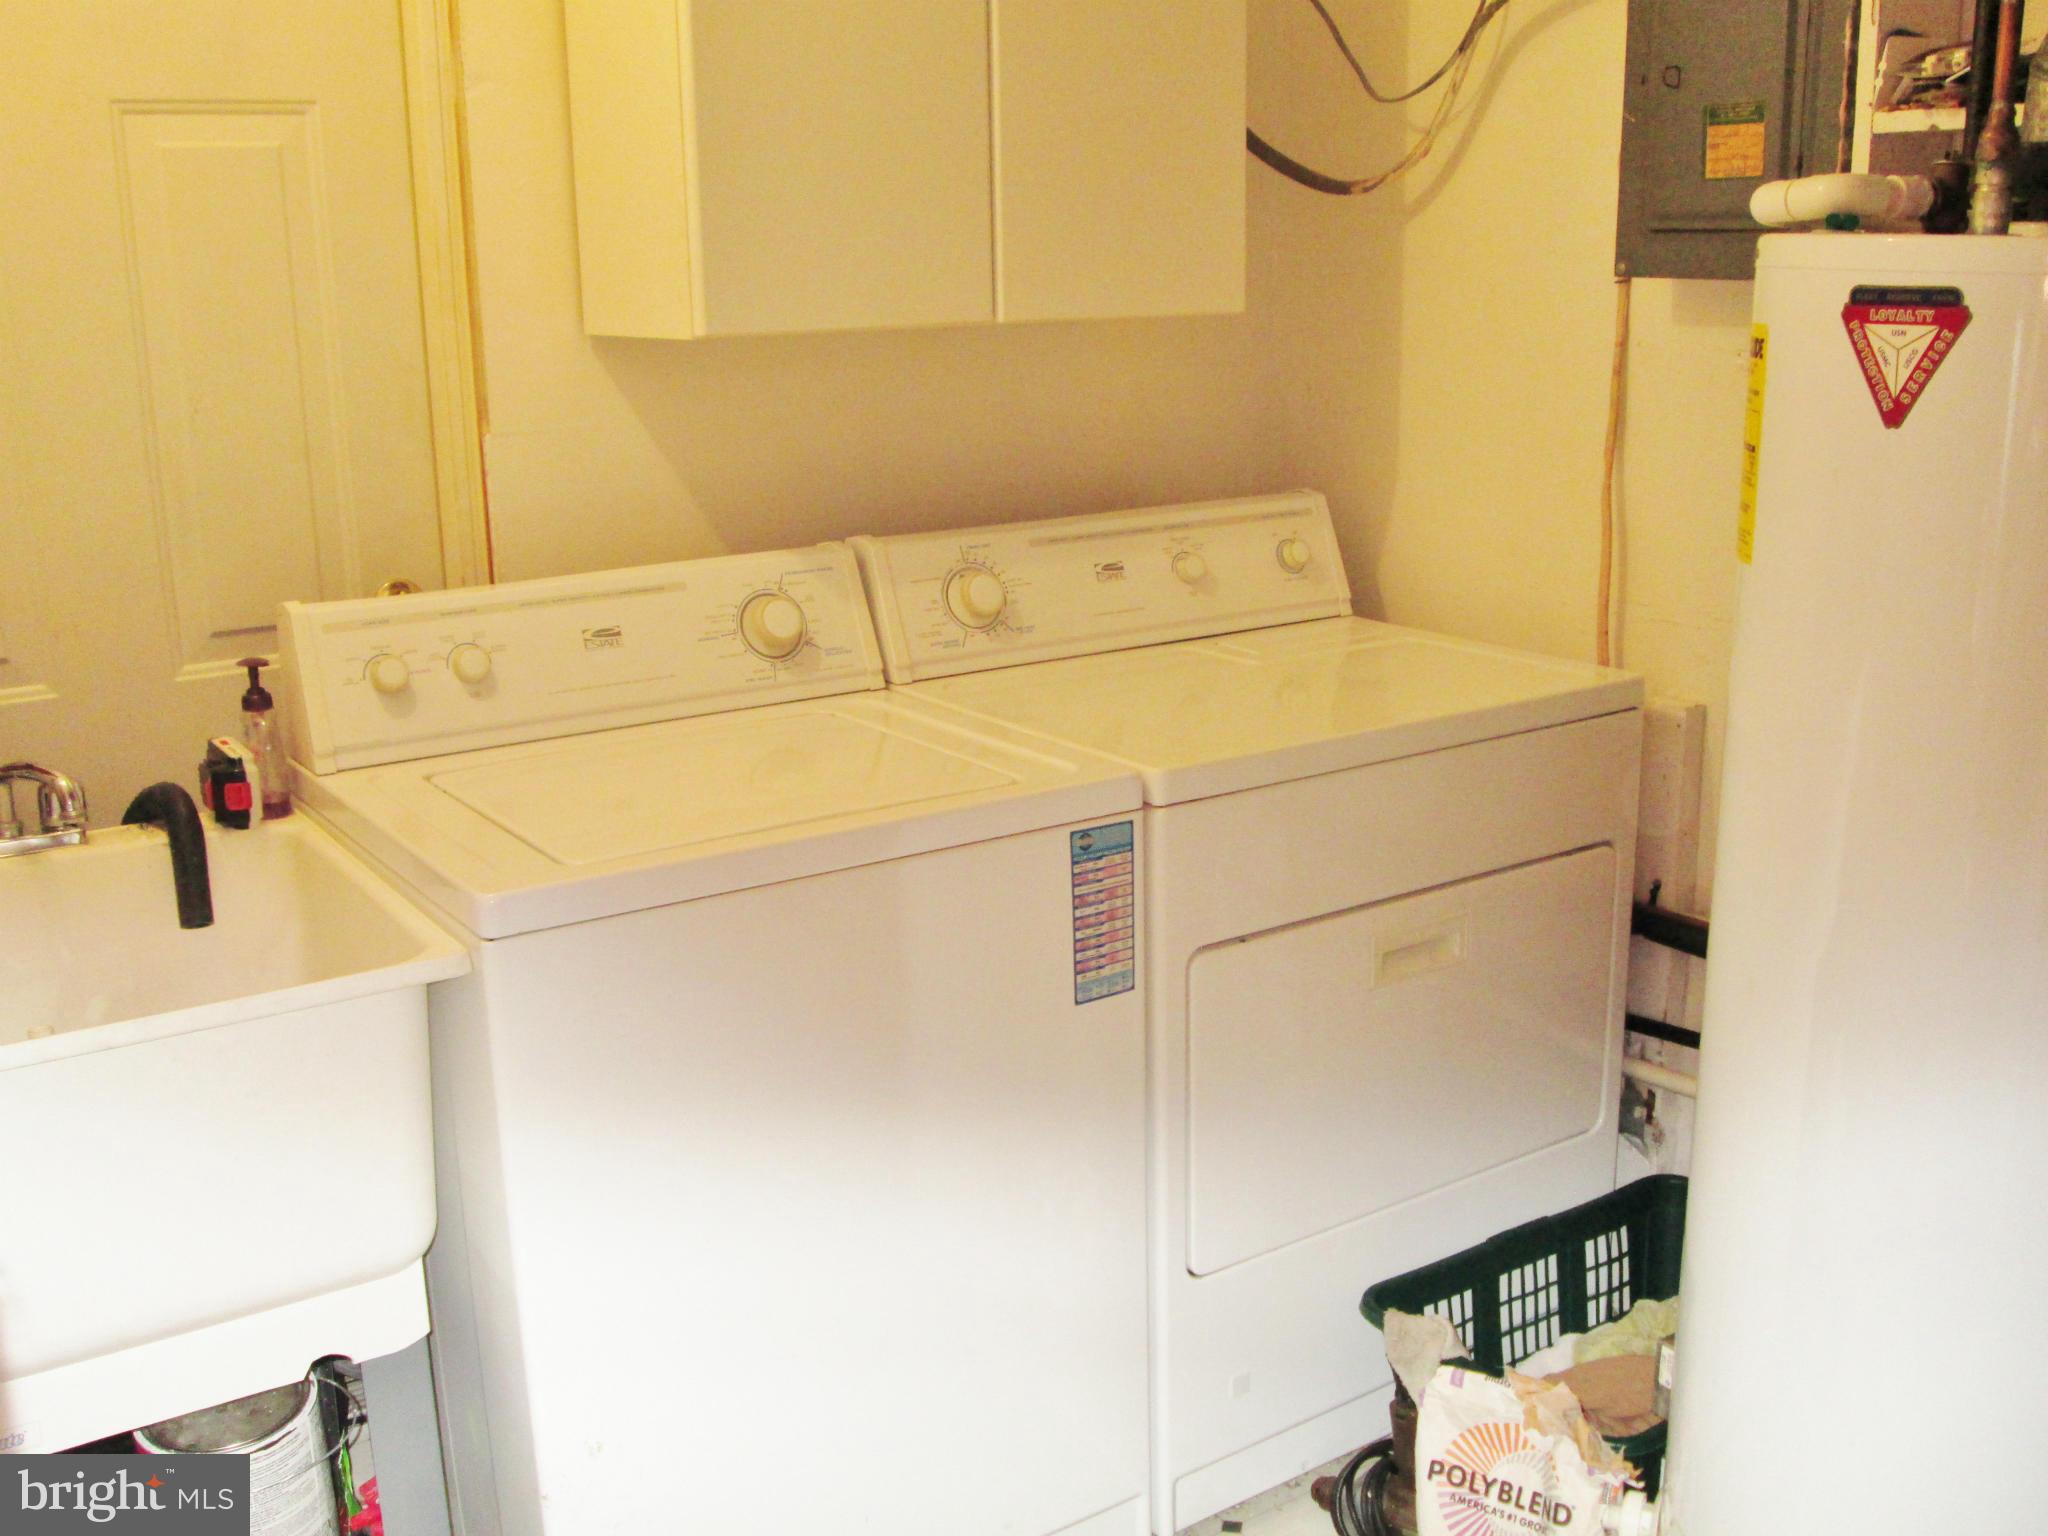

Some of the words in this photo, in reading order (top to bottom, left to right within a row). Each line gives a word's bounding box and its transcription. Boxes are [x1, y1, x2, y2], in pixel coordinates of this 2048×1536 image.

[1870, 308, 1935, 323] LOYALTY
[1891, 328, 1907, 337] USN
[1849, 320, 1894, 412] PROTECTION
[1900, 329, 1954, 405] SERVICE
[1427, 1459, 1573, 1527] POLYBLEND
[1449, 1493, 1505, 1519] AMERICA'S
